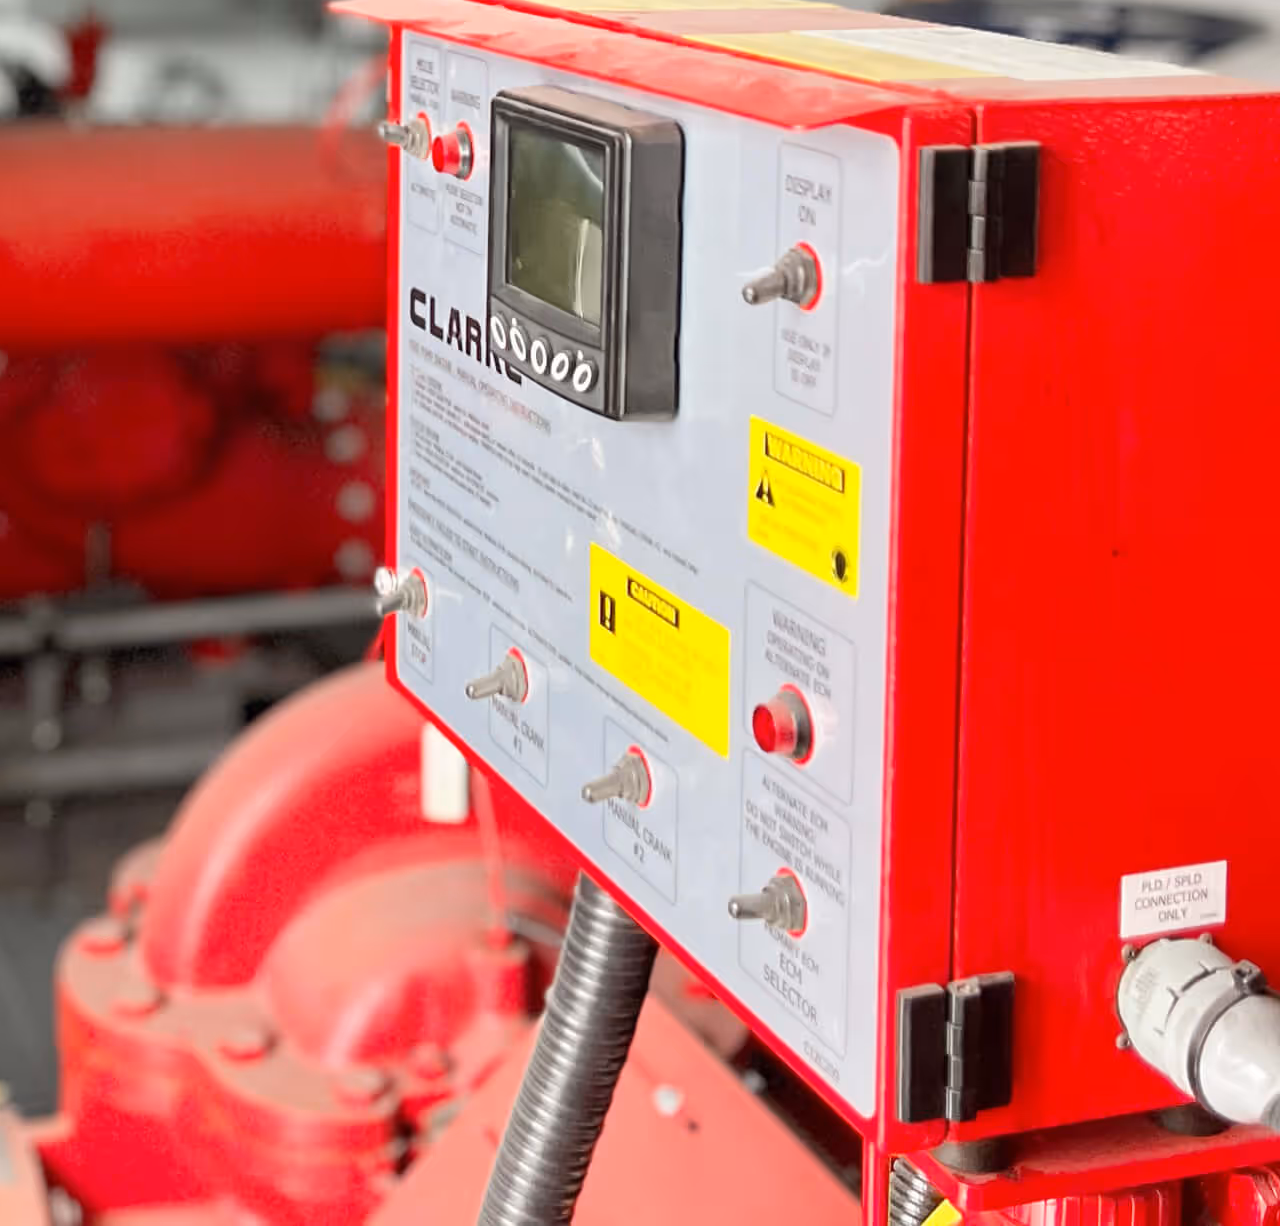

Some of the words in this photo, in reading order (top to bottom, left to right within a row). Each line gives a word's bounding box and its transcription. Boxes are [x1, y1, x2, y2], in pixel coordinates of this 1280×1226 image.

[785, 174, 832, 205] DISPLAY
[798, 205, 816, 226] ON
[767, 435, 841, 492] WARNING
[631, 580, 676, 626] CAUTION
[772, 609, 826, 656] WARNING
[763, 773, 808, 819] ALTERNATE
[607, 797, 641, 839] MANUAL
[642, 826, 673, 864] CRANK
[634, 841, 645, 864] #2
[1141, 877, 1163, 893] PLD
[1174, 872, 1202, 888] SPLD
[1134, 887, 1208, 911] CONNECTION
[1158, 907, 1188, 923] ONLY
[779, 952, 803, 985] ECM
[801, 951, 819, 976] ECM
[762, 963, 818, 1026] SELECTOR
